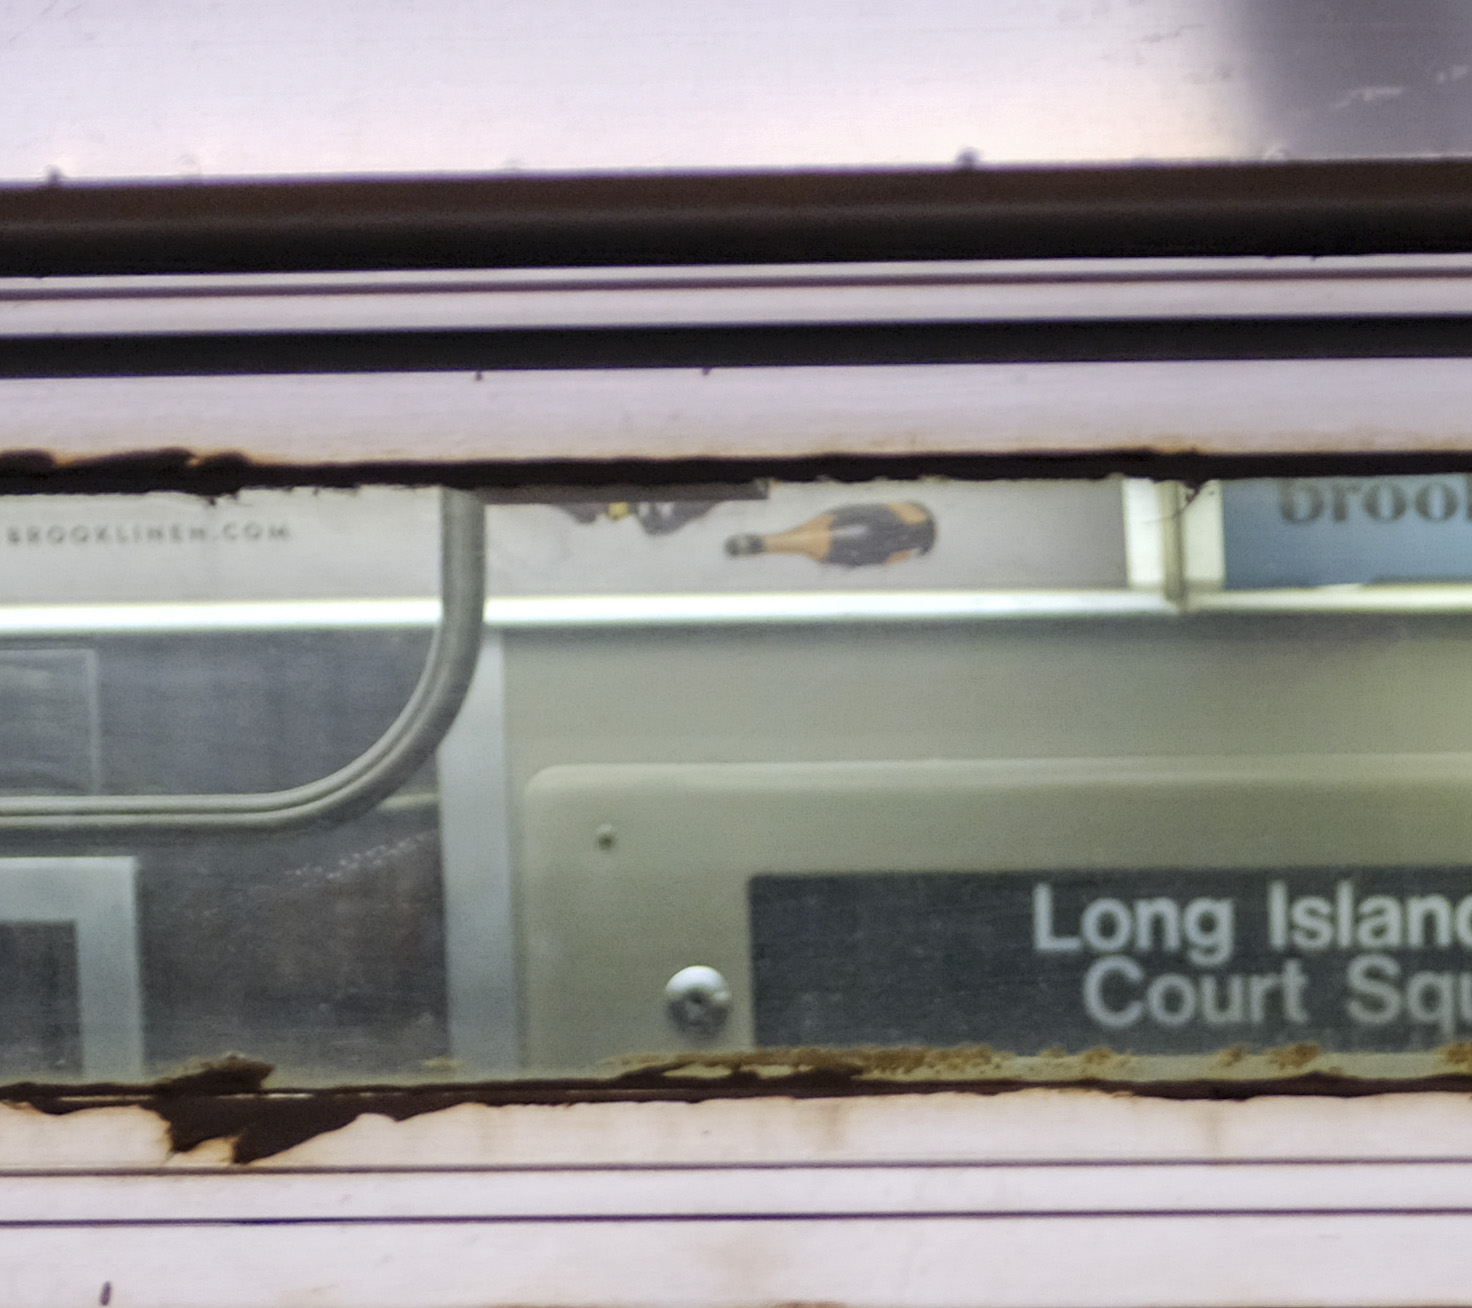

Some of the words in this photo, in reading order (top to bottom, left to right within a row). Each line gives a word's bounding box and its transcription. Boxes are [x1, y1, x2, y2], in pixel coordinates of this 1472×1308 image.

[6, 522, 291, 547] BROOKLINEN.COM
[1033, 881, 1235, 967] Long
[1082, 953, 1310, 1029] Court
